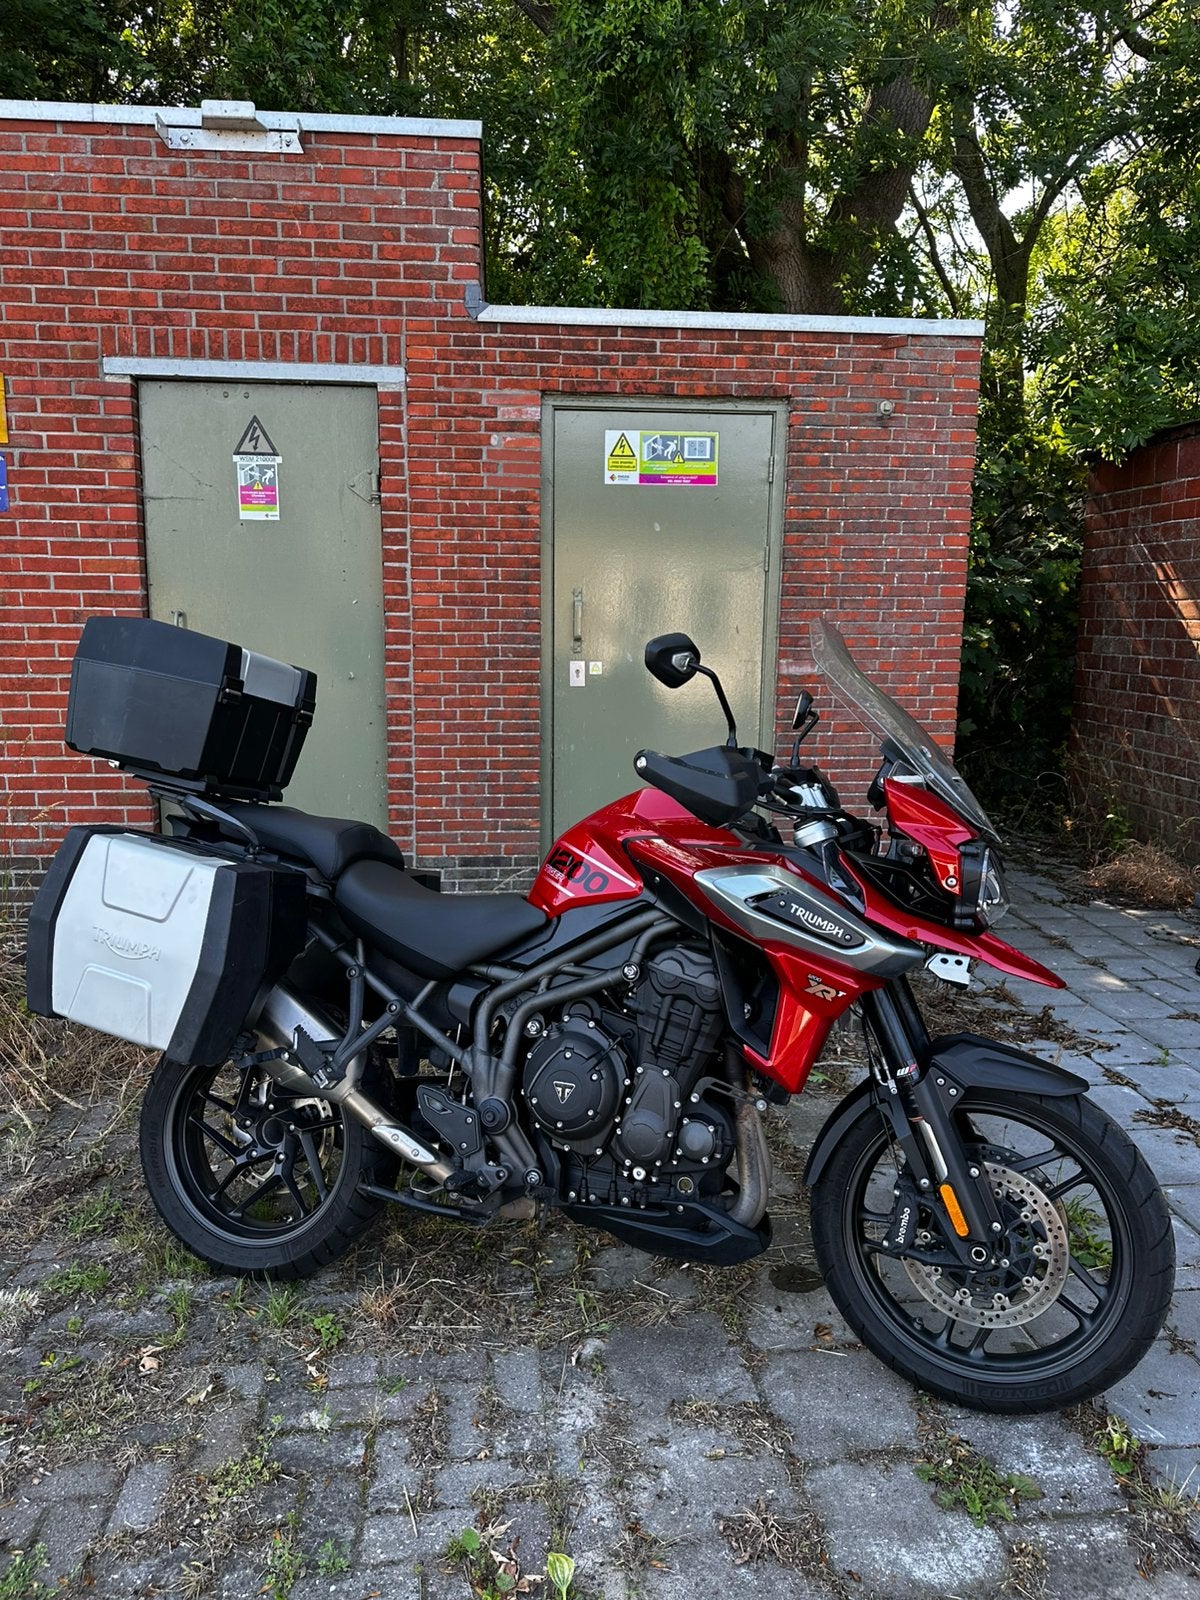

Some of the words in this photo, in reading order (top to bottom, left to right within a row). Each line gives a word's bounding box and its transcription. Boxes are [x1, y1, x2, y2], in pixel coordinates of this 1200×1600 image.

[543, 863, 566, 883] TIGER
[790, 903, 844, 938] TRIUMPH
[92, 926, 162, 962] TRIUMPH
[895, 1207, 911, 1244] brembo
